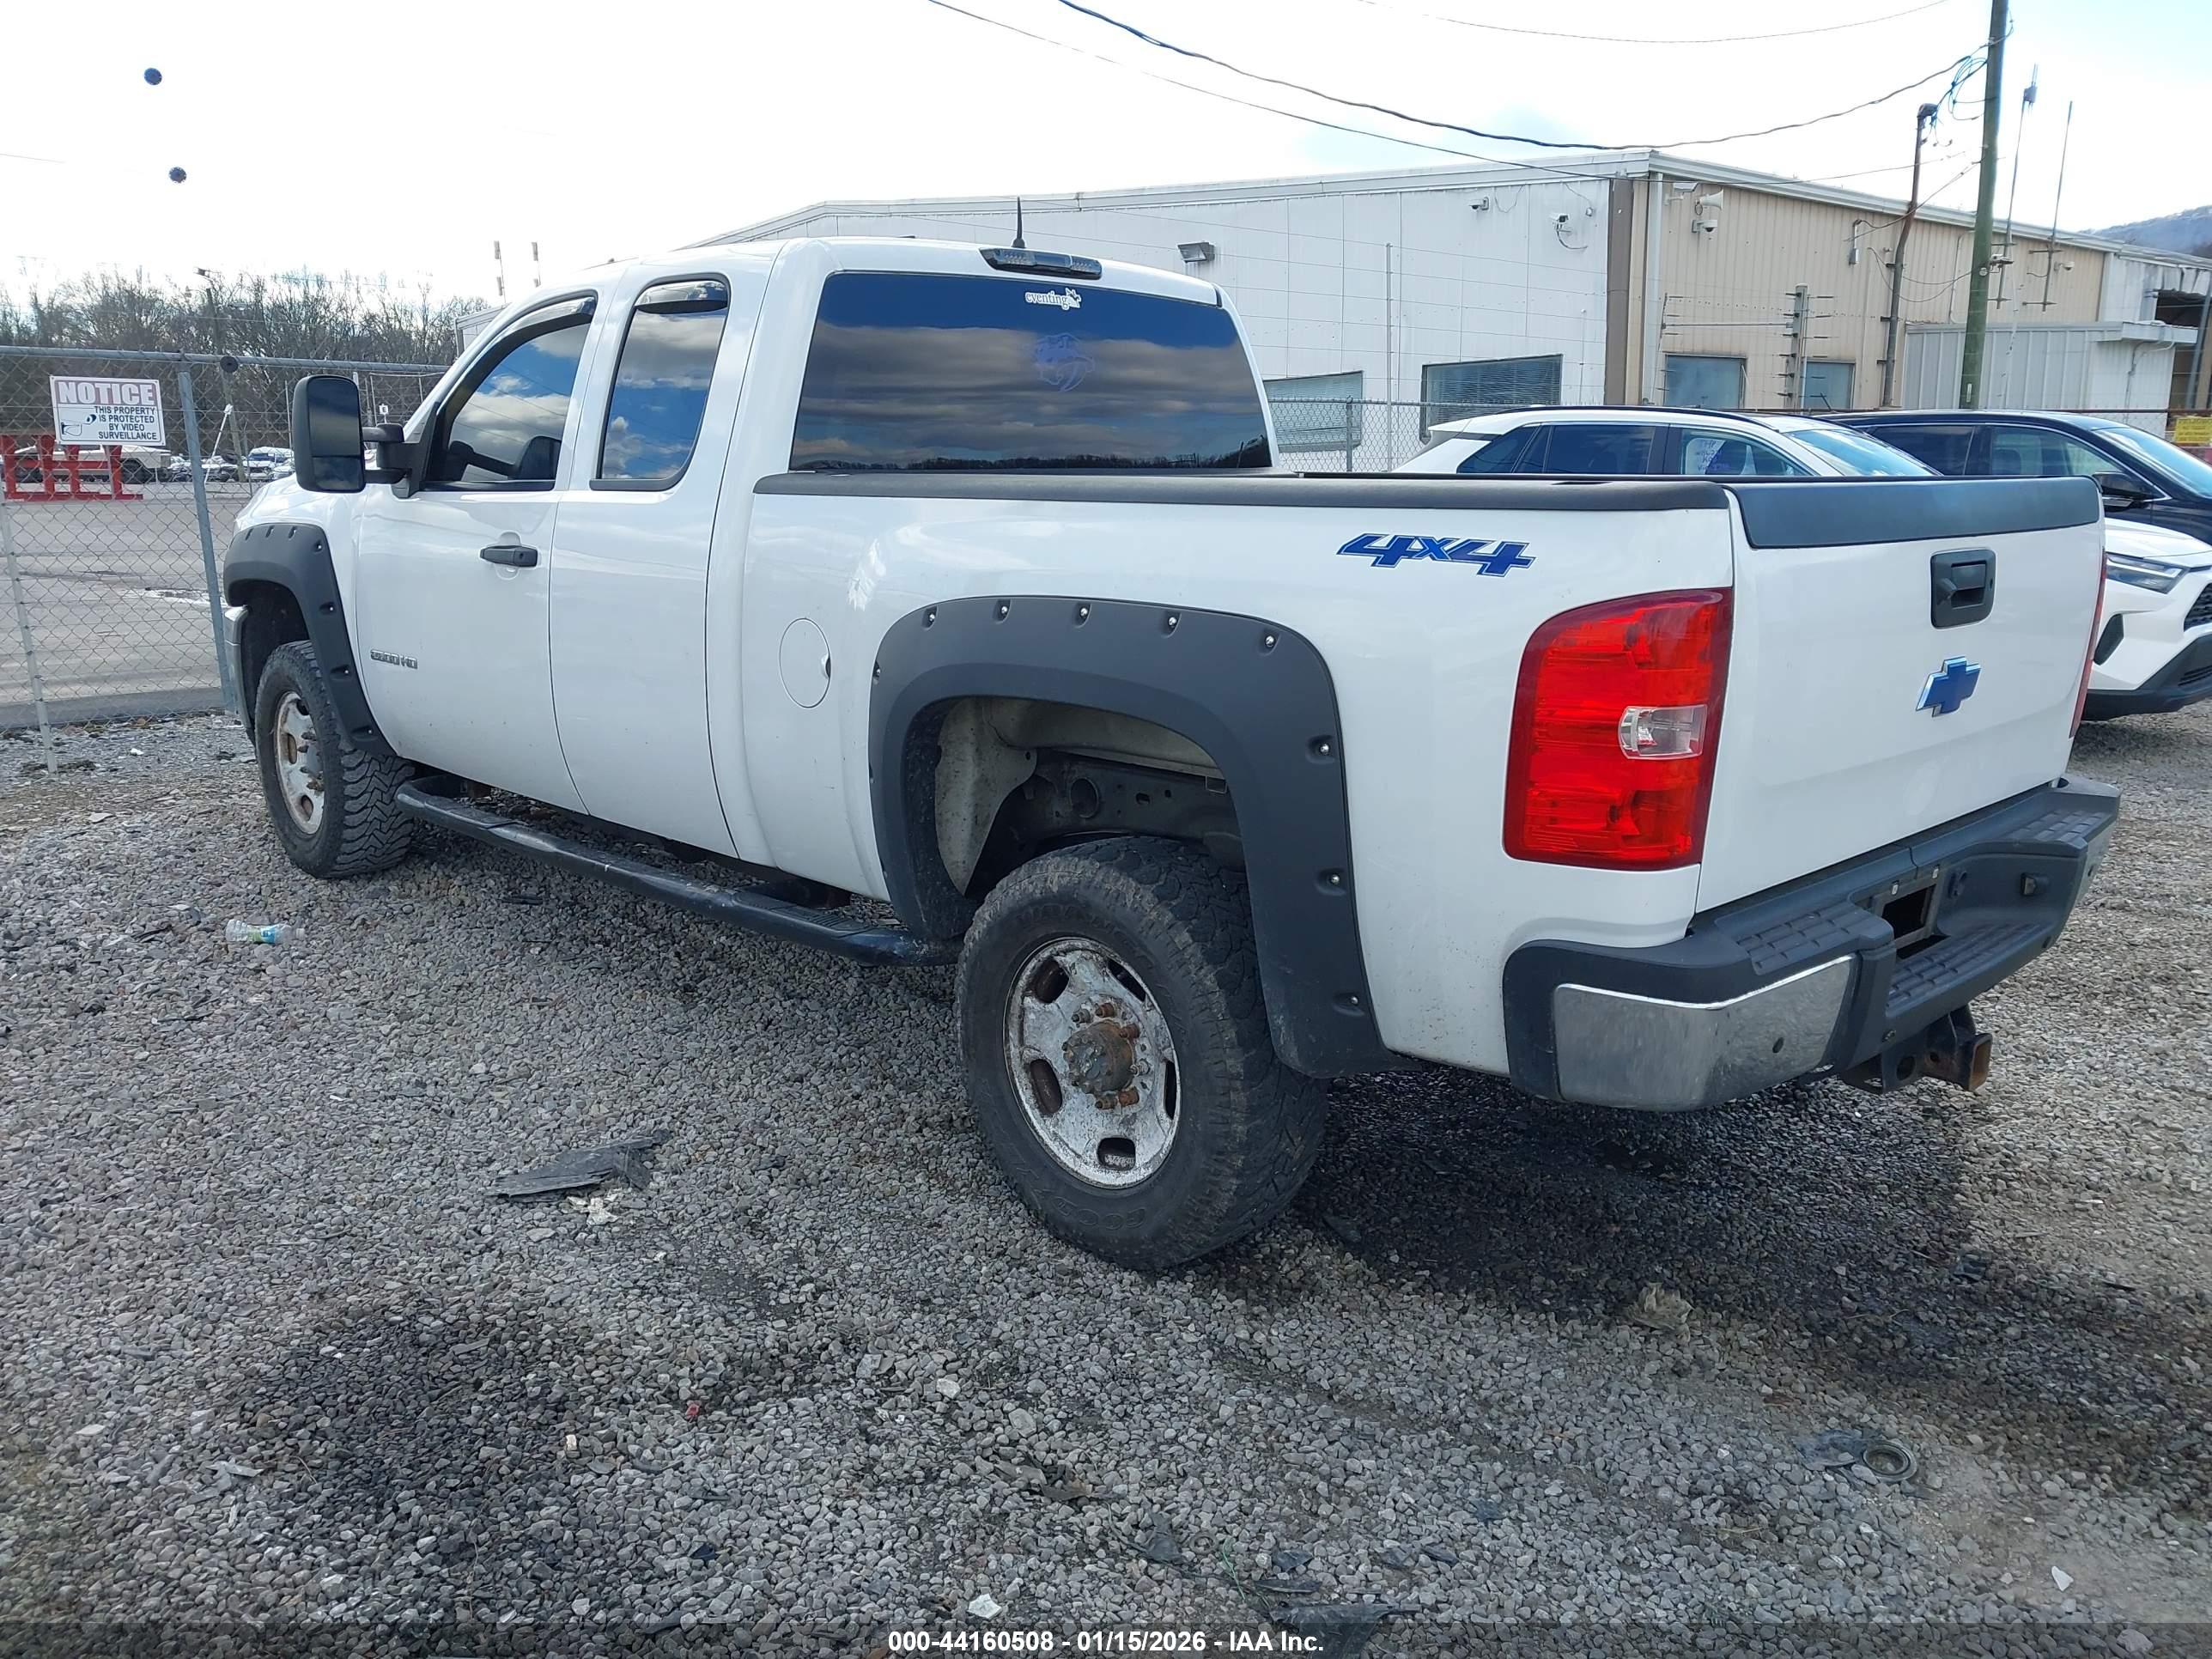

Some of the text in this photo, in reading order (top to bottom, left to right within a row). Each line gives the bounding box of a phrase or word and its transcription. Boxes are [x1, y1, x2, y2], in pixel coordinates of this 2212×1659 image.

[1026, 292, 1068, 309] eventing
[58, 381, 155, 405] NOTICE
[109, 415, 155, 423] PROTECTED
